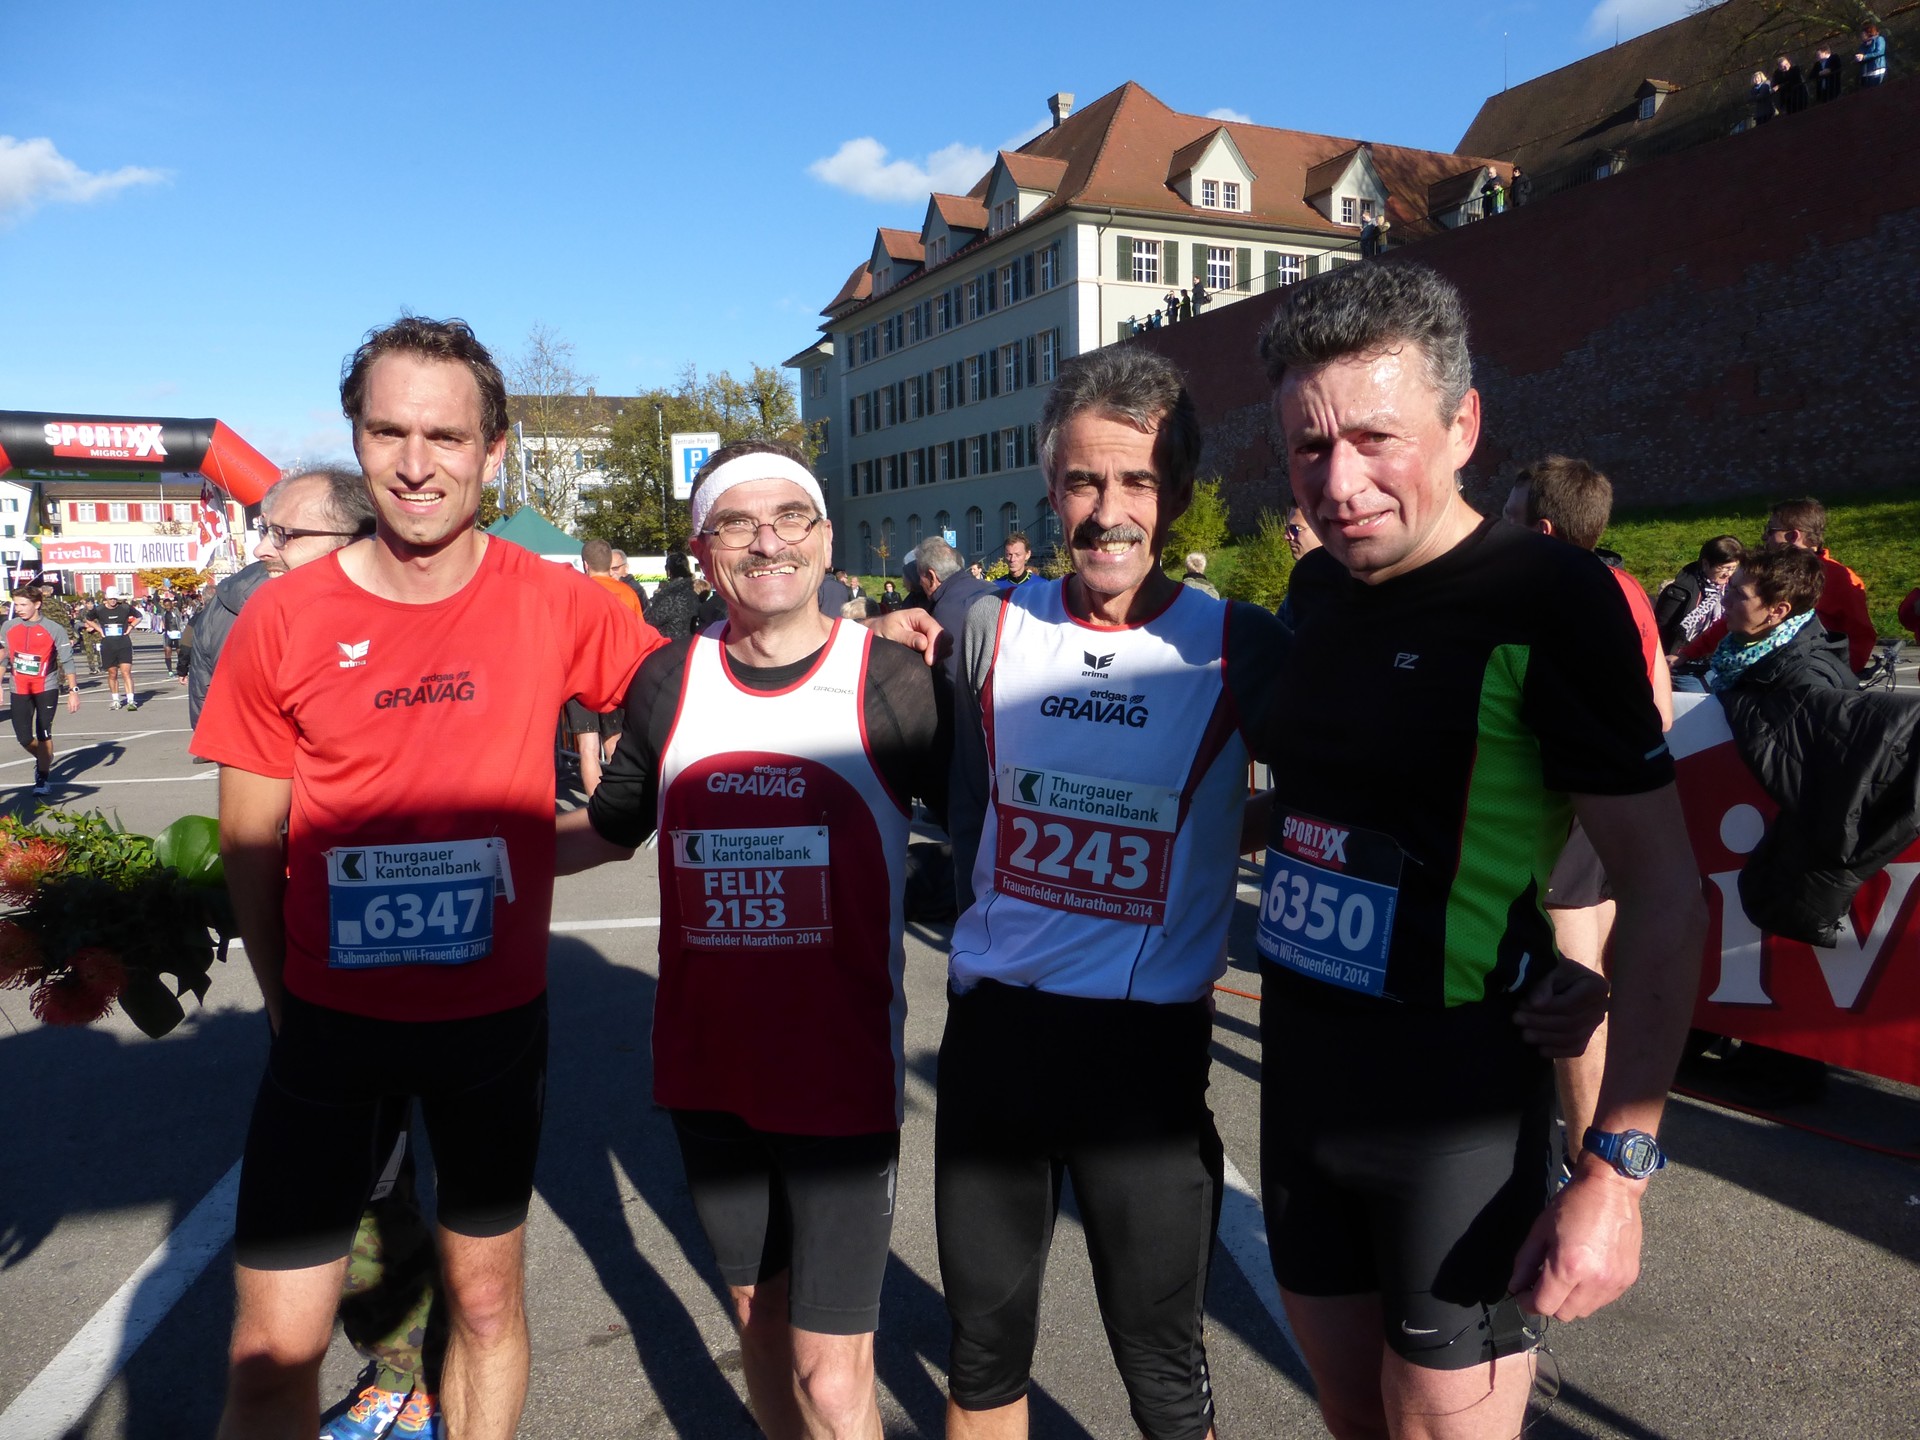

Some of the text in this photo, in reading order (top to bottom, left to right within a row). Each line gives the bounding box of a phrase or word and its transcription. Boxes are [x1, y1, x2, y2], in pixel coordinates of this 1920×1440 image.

[44, 424, 168, 456] SPORTXX
[90, 449, 129, 457] MIGROS
[49, 546, 102, 560] rivella
[339, 659, 366, 668] erima
[1081, 670, 1109, 679] erima
[420, 673, 454, 683] erdgas
[374, 681, 475, 709] GRAVAG
[813, 685, 854, 695] BROOKS
[1090, 690, 1128, 701] erdgas
[1040, 695, 1149, 728] GRAVAG
[753, 765, 787, 776] erdgas
[706, 772, 806, 798] GRAVAG
[1051, 776, 1133, 802] Thurgauer
[1049, 793, 1159, 823] Kantonalbank
[711, 834, 785, 849] Thurgauer
[1282, 816, 1350, 864] SPORTXX
[373, 850, 454, 866] Thurgauer
[712, 847, 811, 862] Kantonalbank
[1009, 816, 1150, 891] 2243
[1298, 845, 1319, 859] MIGROS
[375, 860, 481, 879] Kantonalbank
[704, 870, 785, 896] FELIX
[1002, 875, 1153, 918] Frauenfelder Marathon 2014
[364, 888, 484, 940] 6347
[705, 898, 786, 928] 2153
[1268, 869, 1375, 951] 6350
[686, 931, 822, 946] Frauenfelder Marathon 2014
[337, 942, 486, 964] Halbmarathon Wil-Frauenfeld 2014
[1279, 943, 1341, 980] Wil-Frauenfeld
[1343, 966, 1370, 987] 2014
